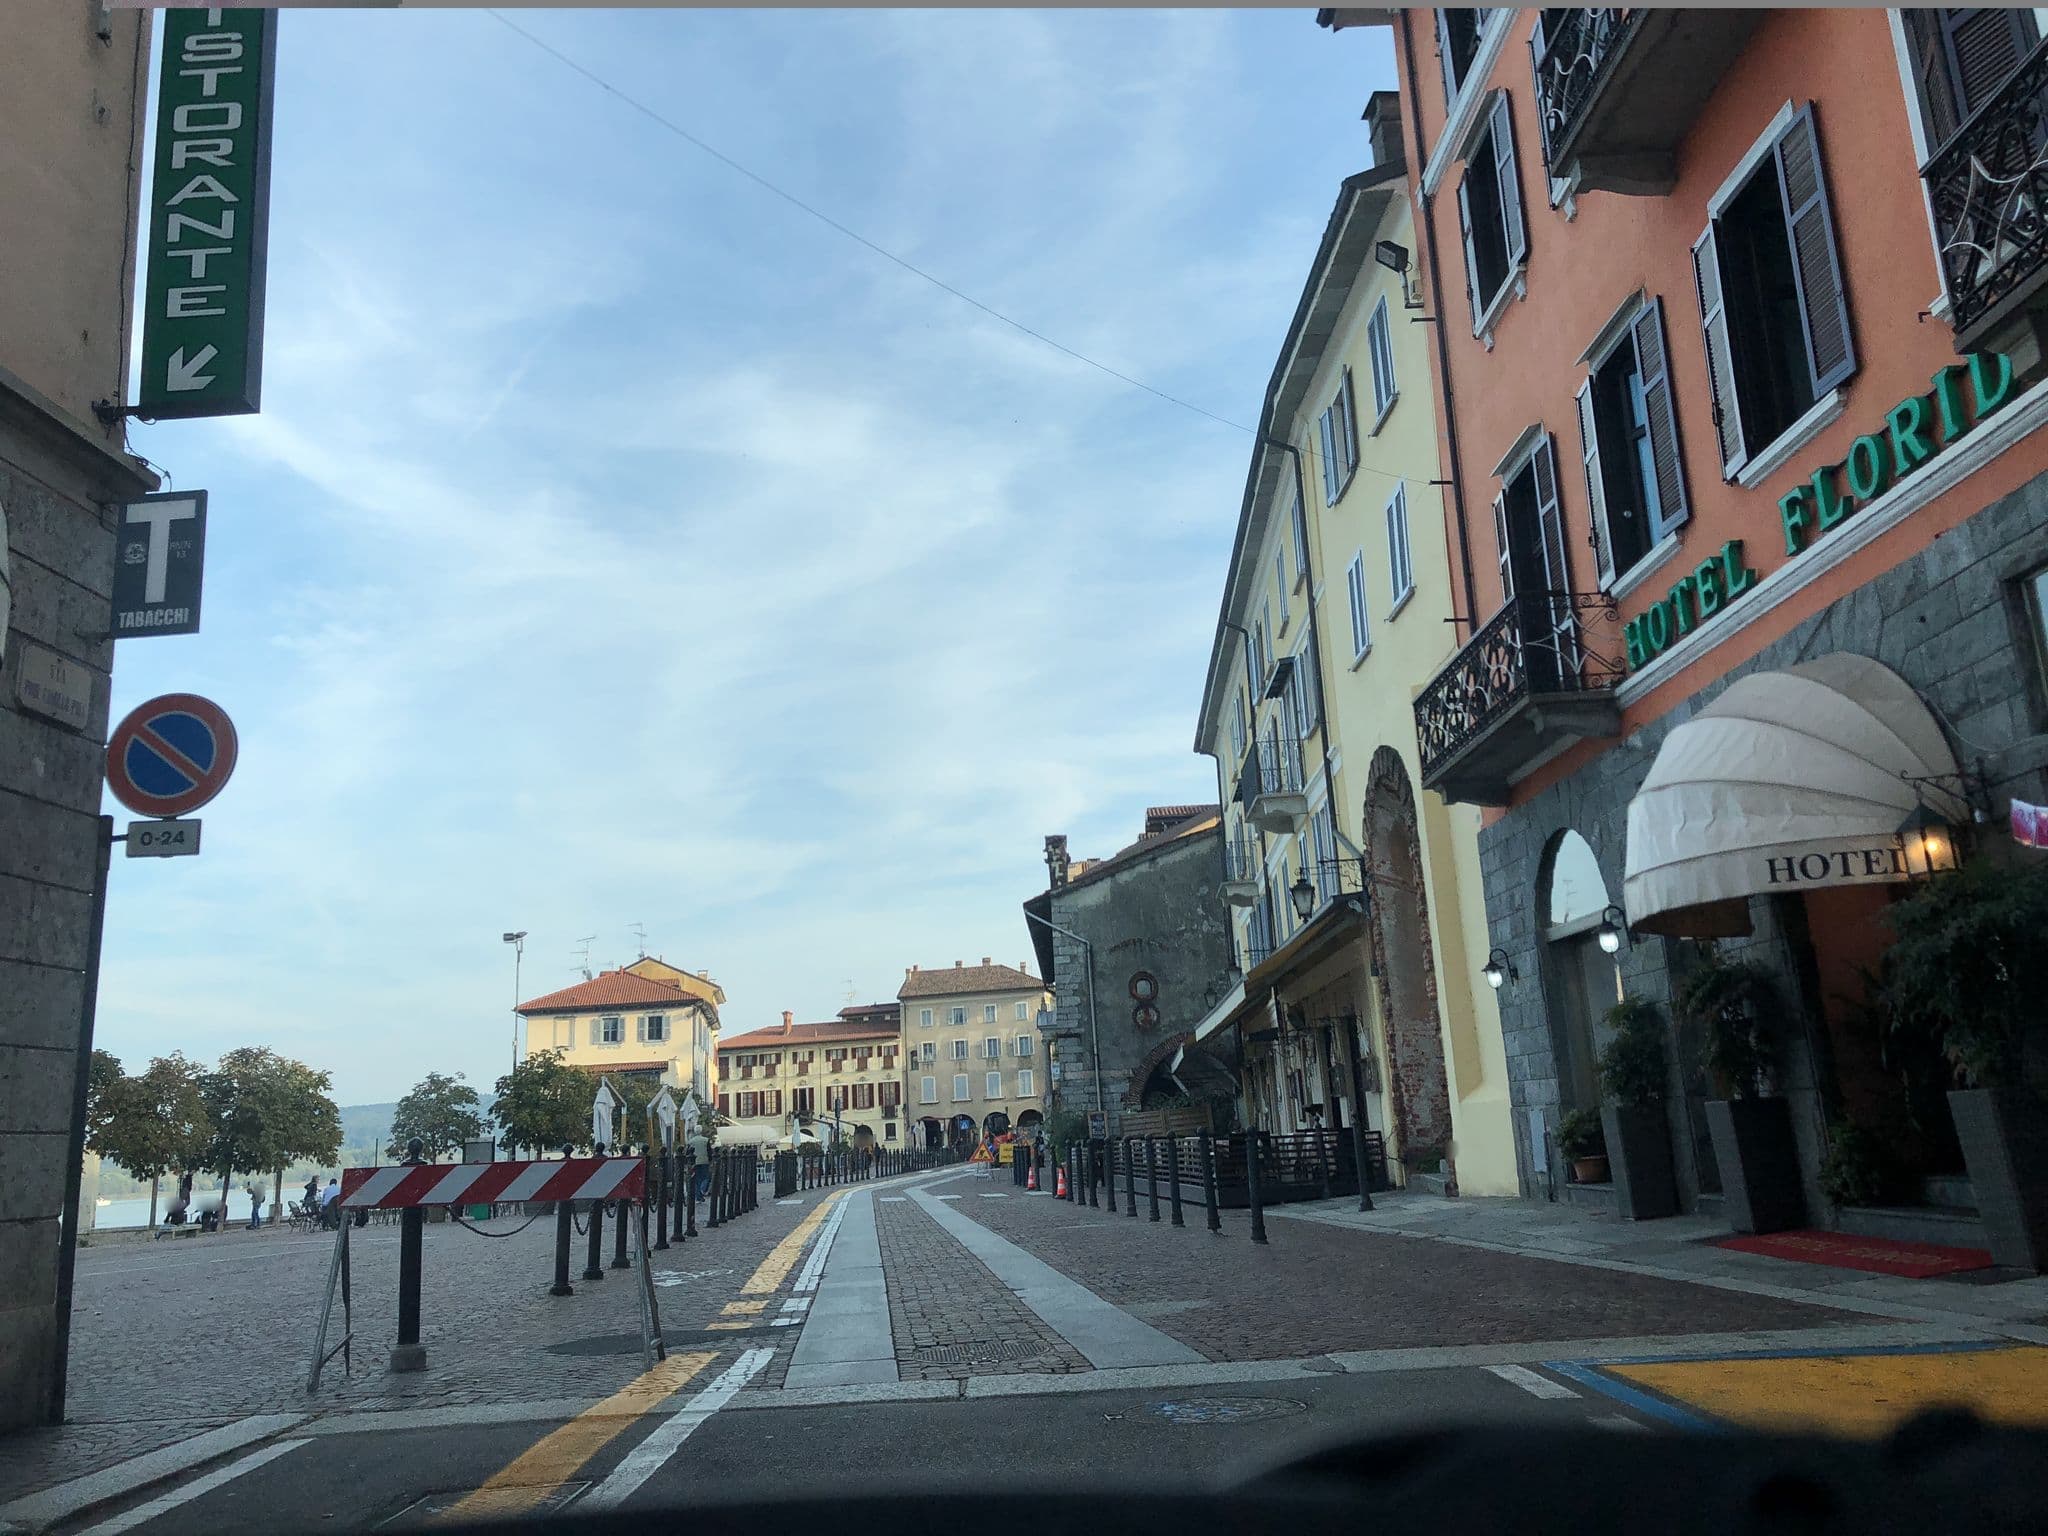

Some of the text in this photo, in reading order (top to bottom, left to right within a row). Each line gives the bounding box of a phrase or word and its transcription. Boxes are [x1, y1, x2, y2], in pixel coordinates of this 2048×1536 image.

[125, 499, 197, 604] T
[119, 607, 190, 628] TABACCHI
[1623, 539, 1757, 671] HOTEL
[140, 830, 185, 846] 0-24
[1765, 848, 1909, 884] HOTEL
